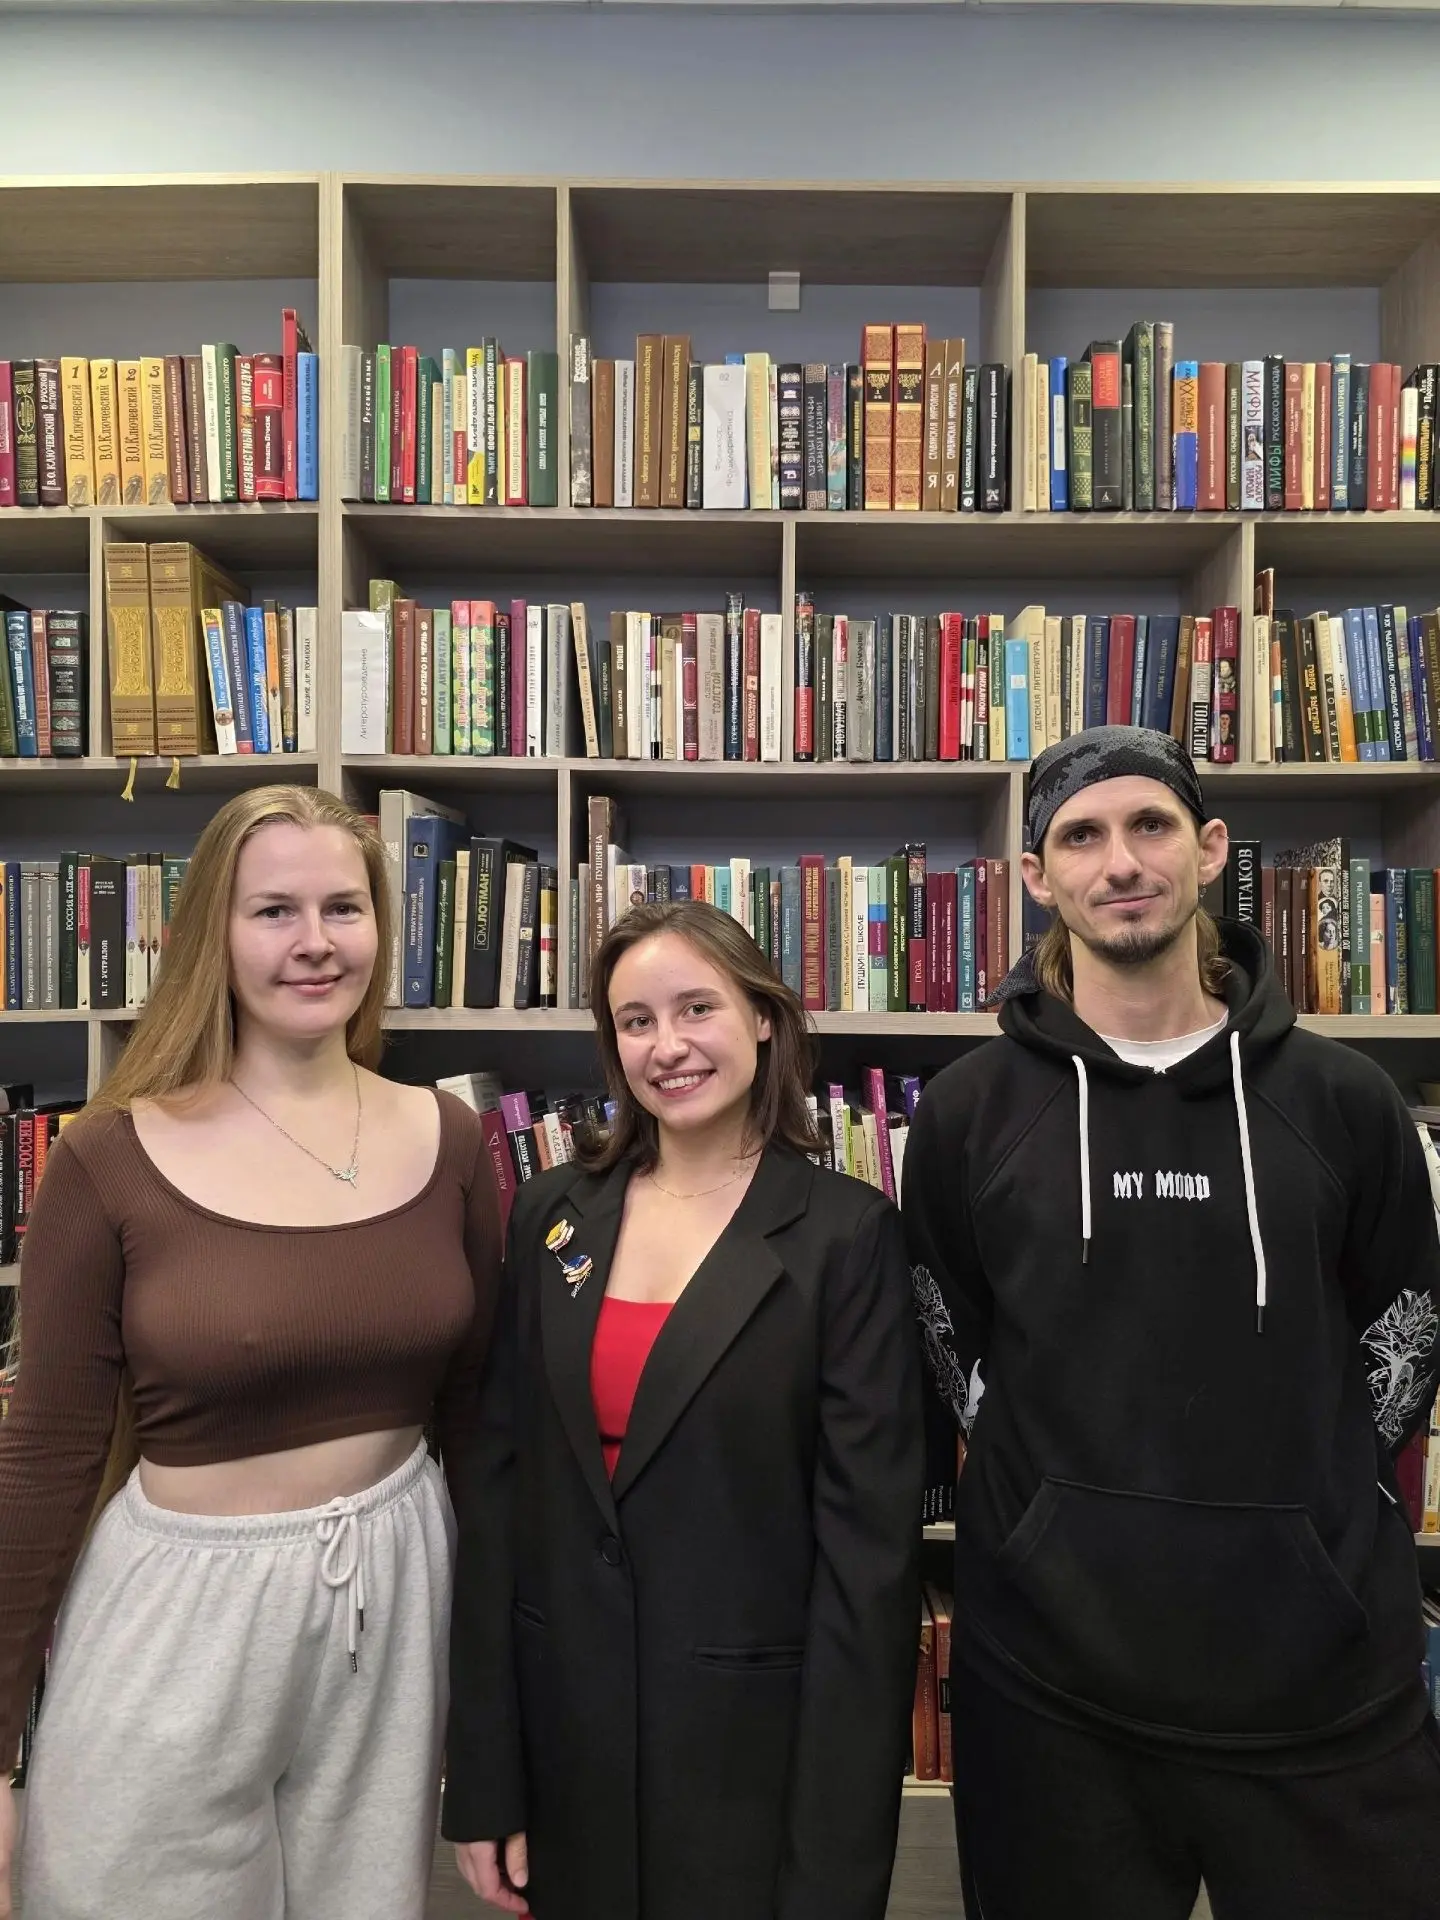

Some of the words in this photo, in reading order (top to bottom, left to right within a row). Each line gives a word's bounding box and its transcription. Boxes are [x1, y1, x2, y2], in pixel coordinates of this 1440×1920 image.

[72, 366, 79, 378] 1
[98, 367, 108, 379] 2
[149, 365, 160, 378] 3
[222, 358, 230, 405] РОССИЙСКОГО
[487, 363, 495, 402] КОРЕЙСКИХ
[574, 345, 582, 382] Русские
[1271, 365, 1281, 398] НАРОДА
[240, 363, 251, 408] КОЖЕДУБ
[363, 385, 371, 423] Русский
[689, 380, 697, 423] ЧУКОВСКИЙ
[929, 384, 939, 419] МИФОЛОГИЯ
[948, 383, 957, 418] МИФОЛОГИЯ
[1247, 371, 1261, 422] МИФЫ
[1337, 378, 1345, 418] АМЕРИКИ
[1424, 369, 1434, 402] Прозоров
[487, 404, 495, 450] ИЕРОГЛИФОВ
[1271, 400, 1281, 441] РУССКОГО
[43, 413, 55, 469] КЛЮЧЕВСКИЙ
[930, 423, 938, 460] СЛАВЯНСКАЯ
[947, 422, 956, 459] СЛАВЯНСКАЯ
[47, 471, 56, 485] В.О.
[240, 427, 254, 495] НЕИЗВЕСТНЫЙ
[641, 454, 649, 483] словарь
[668, 454, 678, 482] словарь
[1269, 444, 1282, 489] МИФЫ
[1246, 467, 1255, 499] НАРОДА
[1255, 464, 1263, 502] РУССКОГО
[227, 605, 236, 633] ИСТОРИЯ
[207, 631, 221, 668] МОСКВЫ
[230, 635, 242, 690] МЕЖДУНАРОДНЫХ
[437, 630, 447, 685] ЛИТЕРАТУРА
[1033, 641, 1041, 691] ЛИТЕРАТУРА
[1385, 630, 1395, 671] ЛИТЕРАТУРЫ
[359, 648, 368, 739] Литературоведение
[712, 672, 721, 714] ТОЛСТОЙ
[978, 671, 987, 718] МИХАЛКОВЫ
[1307, 664, 1319, 691] ГОВОРИ
[1389, 674, 1401, 718] ЗАРУБЕЖНОЙ
[218, 692, 226, 704] Все
[236, 693, 247, 731] ОТНОШЕНИЙ
[437, 691, 446, 729] ДЕТСКАЯ
[1034, 694, 1042, 731] ДЕТСКАЯ
[1310, 696, 1321, 734] ВЫСТУПАЙ
[1325, 676, 1338, 747] ИВАНОВА
[834, 702, 846, 744] БУЛГАКОВ
[1193, 704, 1208, 754] ТОЛСТОЙ
[1393, 720, 1402, 751] ИСТОРИЯ
[595, 835, 603, 880] ПУШКИНА
[66, 880, 74, 893] XIX
[478, 873, 490, 923] ЛОТМАН
[1238, 849, 1253, 922] УЛГАКОВ
[66, 899, 74, 931] РОССИЯ
[1342, 912, 1350, 938] ПИСАТЕЛЕЙ
[806, 923, 820, 953] РОССИИ
[1342, 940, 1350, 950] 100
[1396, 922, 1406, 960] СУДЬБЫ
[806, 957, 820, 999] ПИСАТЕЛИ
[857, 952, 865, 989] ПУШКИН
[875, 957, 884, 967] 50
[914, 960, 922, 983] ГРОЗА
[19, 1120, 33, 1169] РОССИИ
[1112, 1171, 1144, 1200] MY
[1155, 1169, 1210, 1202] MOOD
